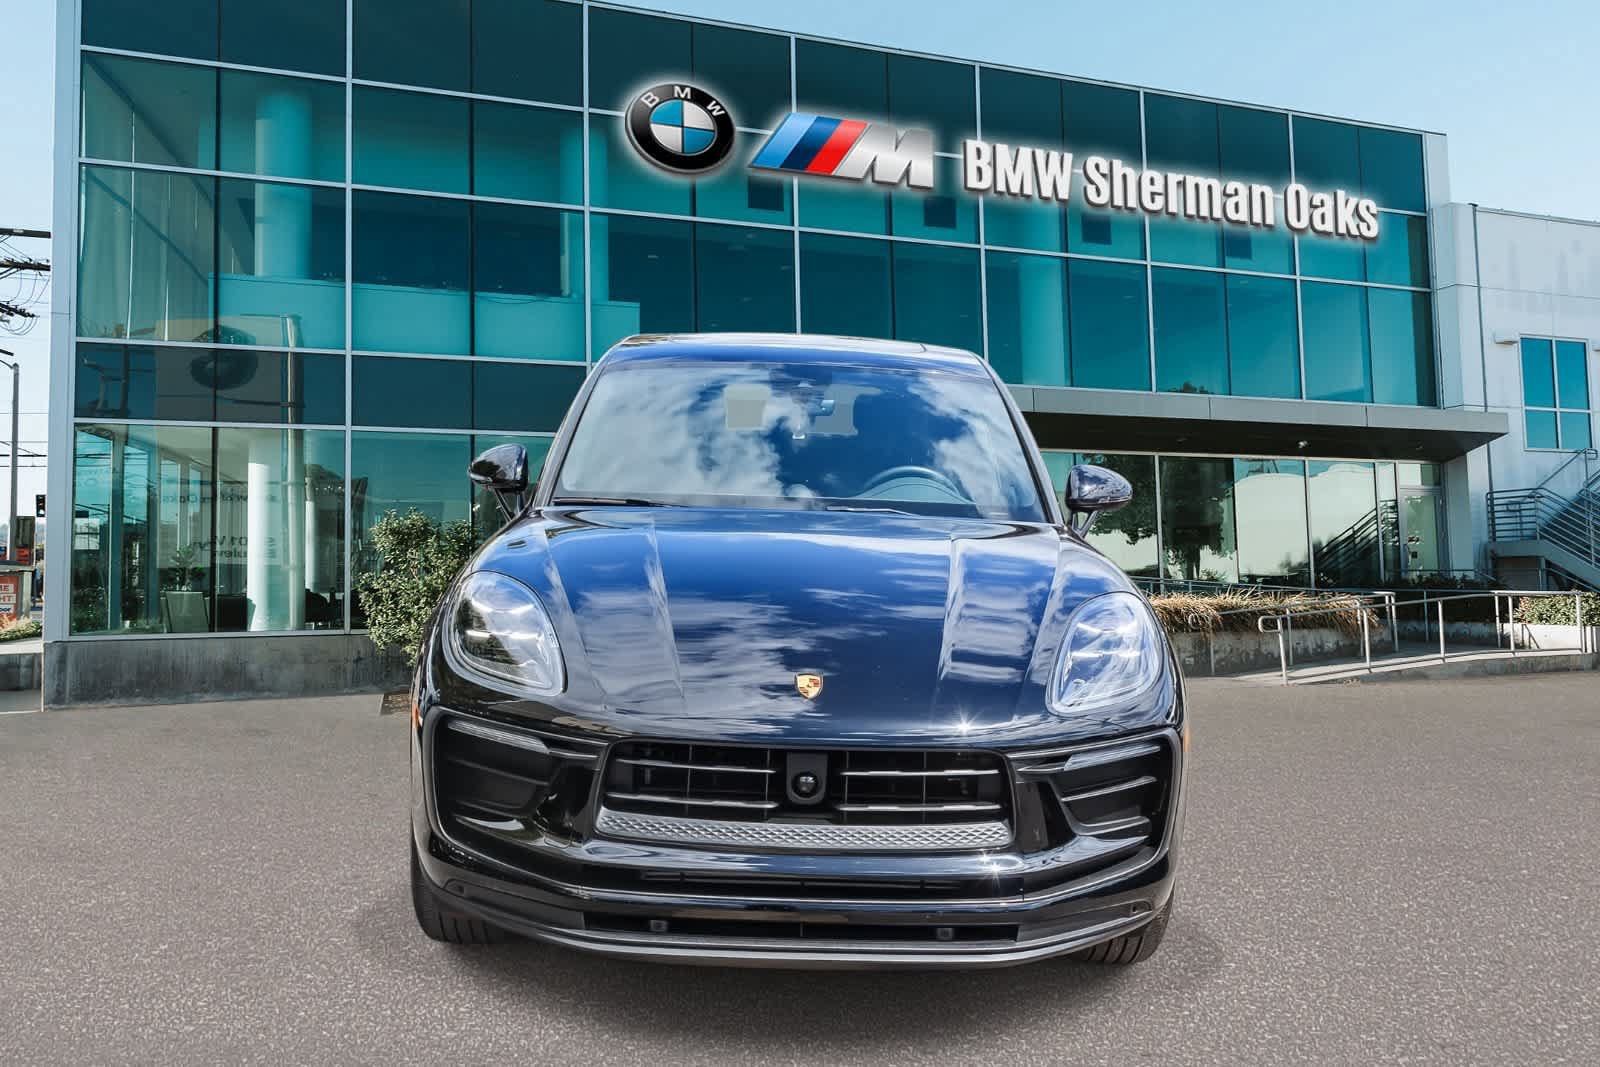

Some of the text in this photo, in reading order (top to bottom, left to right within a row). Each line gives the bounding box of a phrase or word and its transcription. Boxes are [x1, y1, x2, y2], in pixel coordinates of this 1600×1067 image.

[641, 86, 725, 117] BMW
[964, 139, 1380, 240] BMW Sherman Oaks
